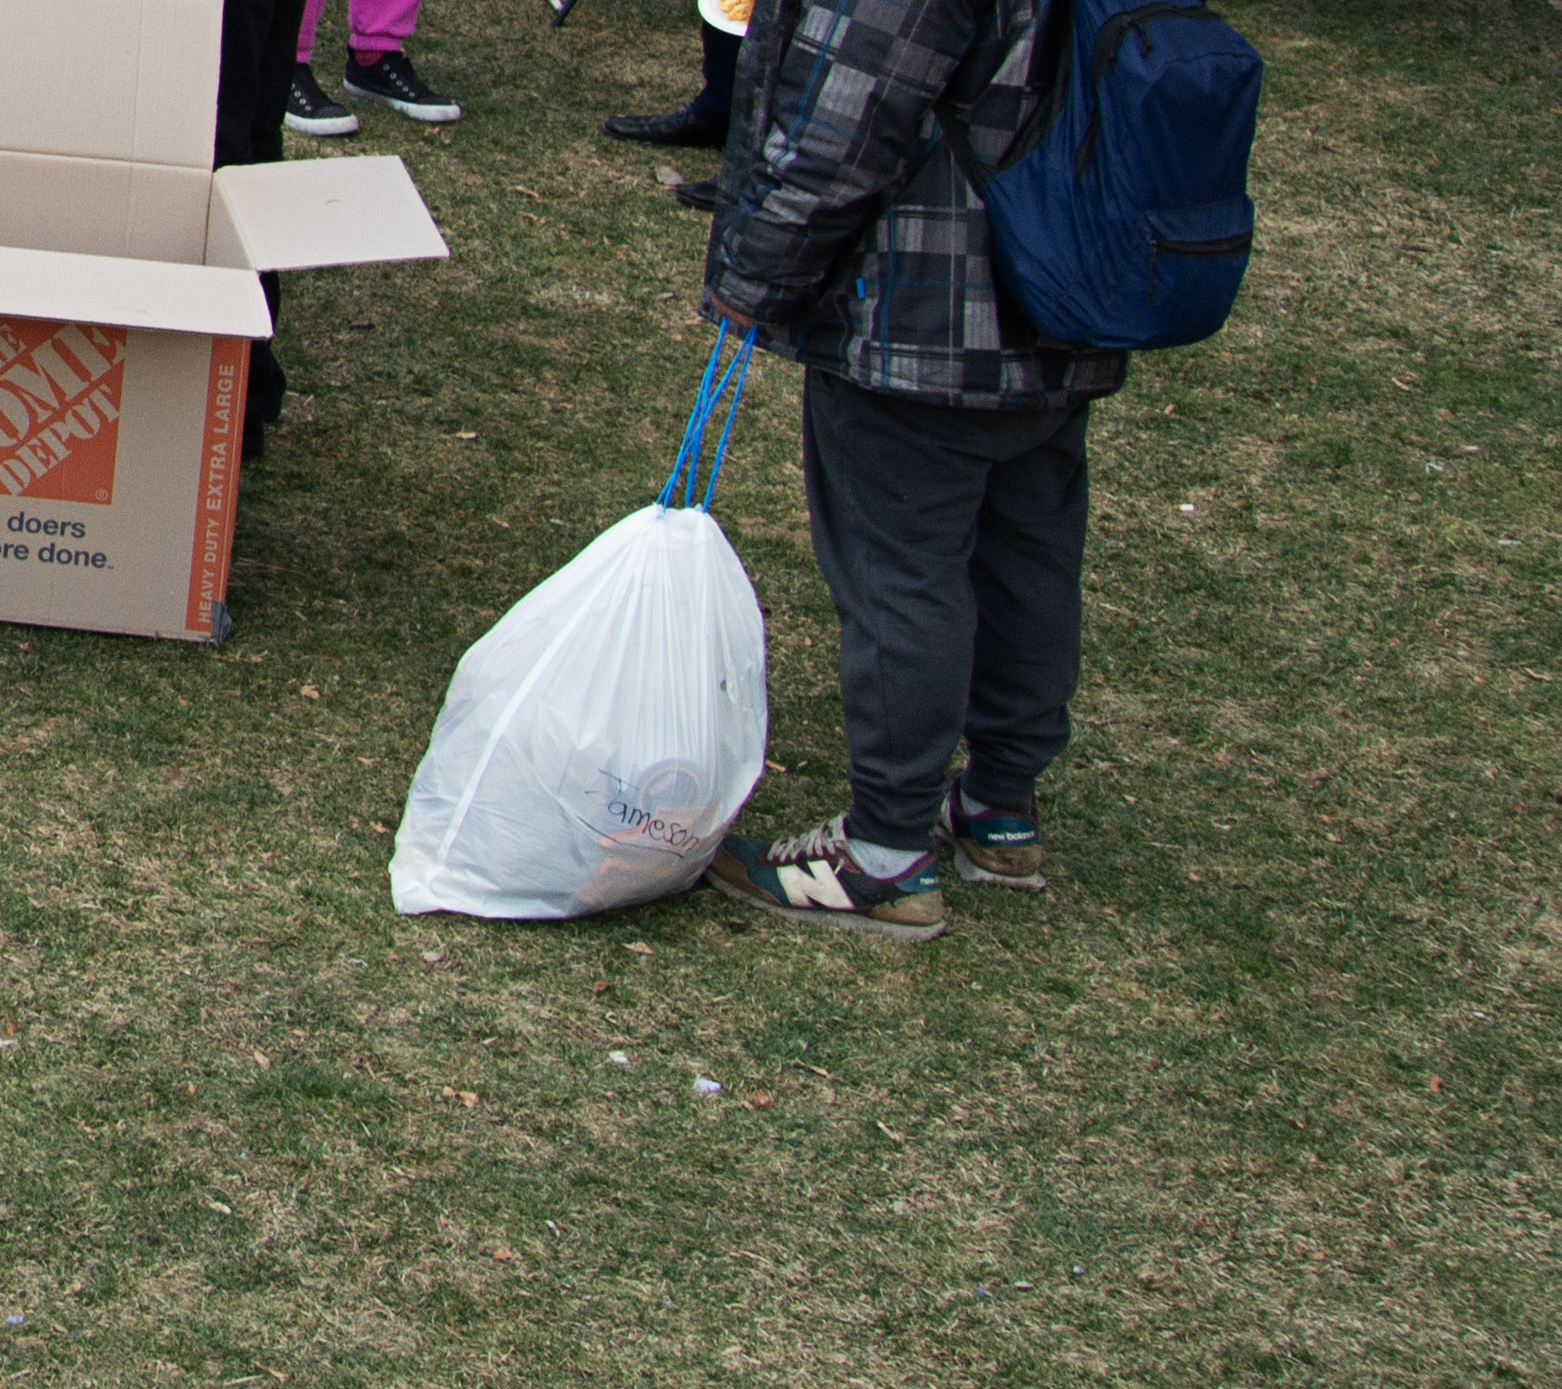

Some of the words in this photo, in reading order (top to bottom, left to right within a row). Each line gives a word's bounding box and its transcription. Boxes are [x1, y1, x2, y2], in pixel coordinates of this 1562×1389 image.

[214, 363, 237, 440] LARGE
[208, 447, 228, 512] EXTRA
[7, 511, 87, 539] doers
[203, 521, 221, 563] DUTY
[199, 568, 215, 625] HEAVY
